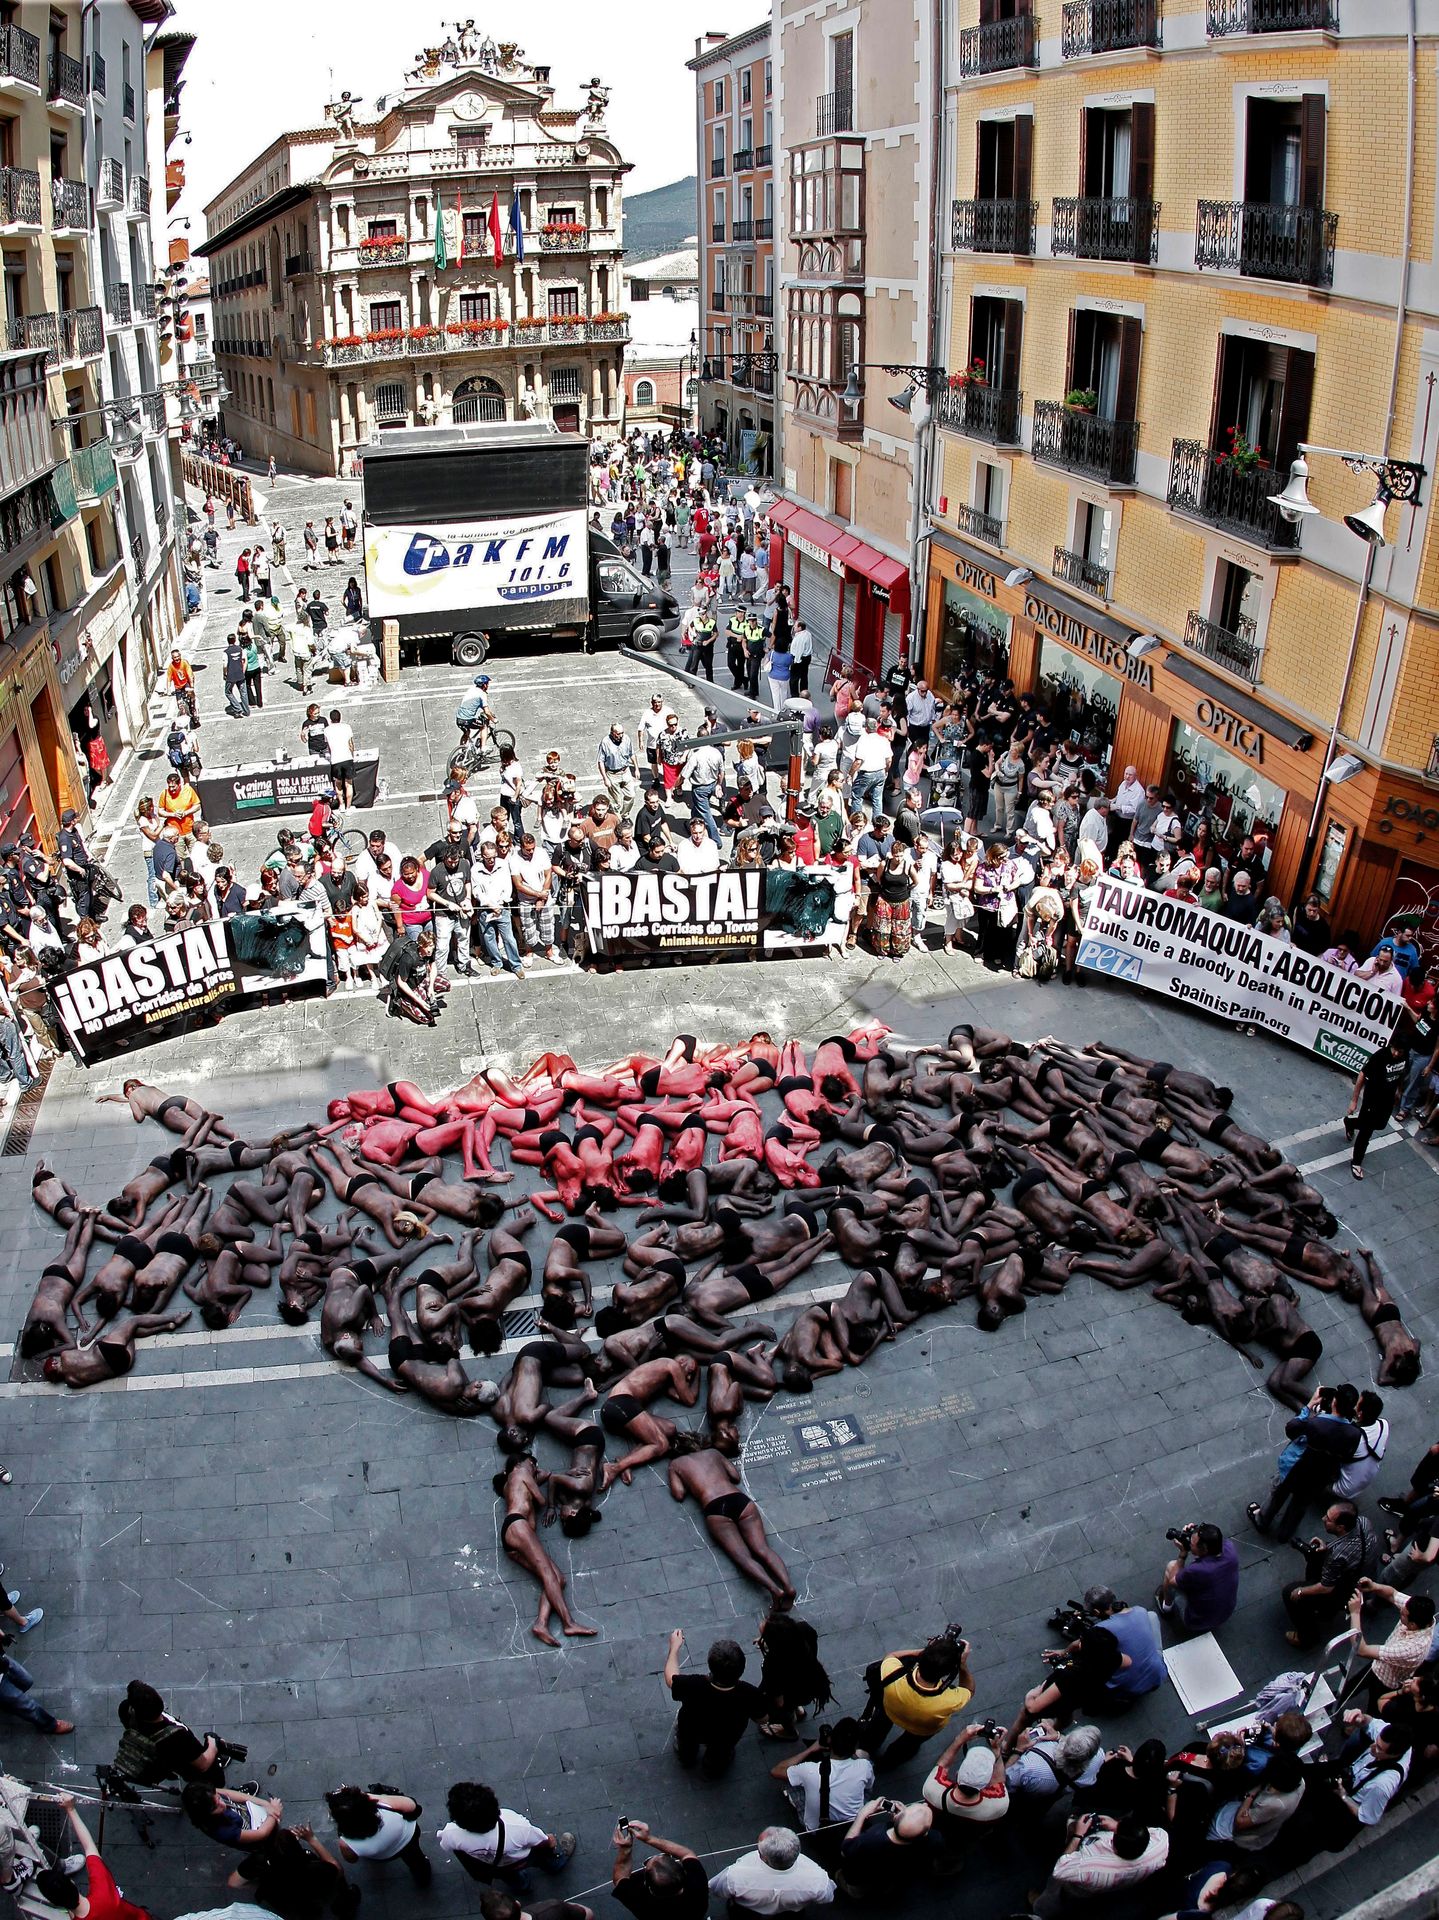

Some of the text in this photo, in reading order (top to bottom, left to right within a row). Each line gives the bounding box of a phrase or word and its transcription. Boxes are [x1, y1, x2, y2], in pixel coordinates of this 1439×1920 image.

[508, 562, 570, 583] 101.6
[501, 581, 568, 596] pamplona
[1195, 699, 1264, 764] OPTICA
[276, 774, 330, 787] POR LA DEFENSA
[277, 786, 298, 795] TODOS
[298, 784, 310, 794] LOS
[603, 920, 758, 938] NO más Corridas de Toros
[660, 934, 758, 947] AnimaNaturalis.org
[1088, 916, 1129, 942] Bulls
[1132, 931, 1160, 953] Die
[1164, 945, 1175, 960] a
[1178, 948, 1235, 983] Bloody
[1236, 970, 1284, 1001] Death
[1288, 991, 1304, 1012] in
[1308, 1001, 1388, 1048] Pamplona
[1271, 950, 1402, 1030] ABOLICIÓN
[84, 969, 234, 1034] NO más Corridas de Toros
[145, 981, 236, 1024] AnimaNaturalis.org
[1334, 1051, 1364, 1070] natura
[1337, 1044, 1368, 1064] anim
